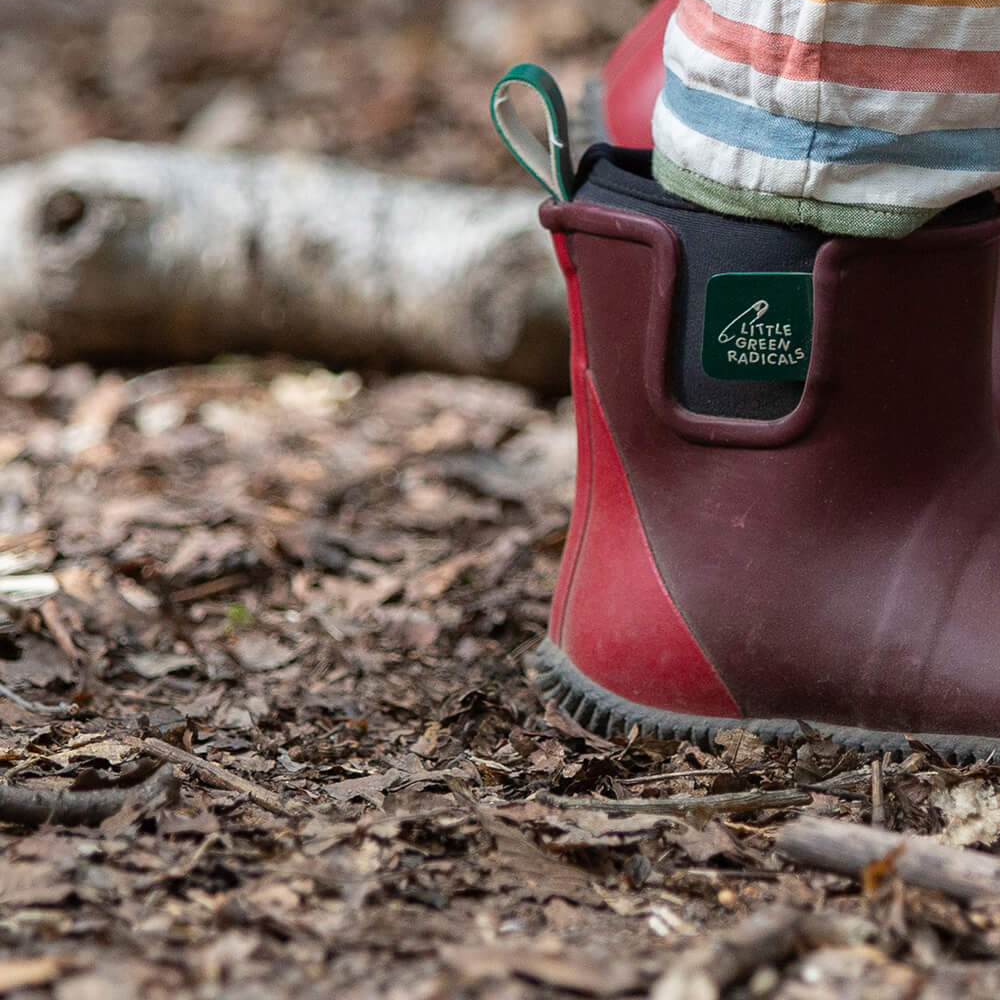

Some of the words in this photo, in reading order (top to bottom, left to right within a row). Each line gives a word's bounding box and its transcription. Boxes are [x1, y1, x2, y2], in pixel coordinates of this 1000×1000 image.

[741, 322, 792, 336] LITTLE
[735, 337, 790, 351] GREEN
[727, 348, 804, 366] RADICALS
